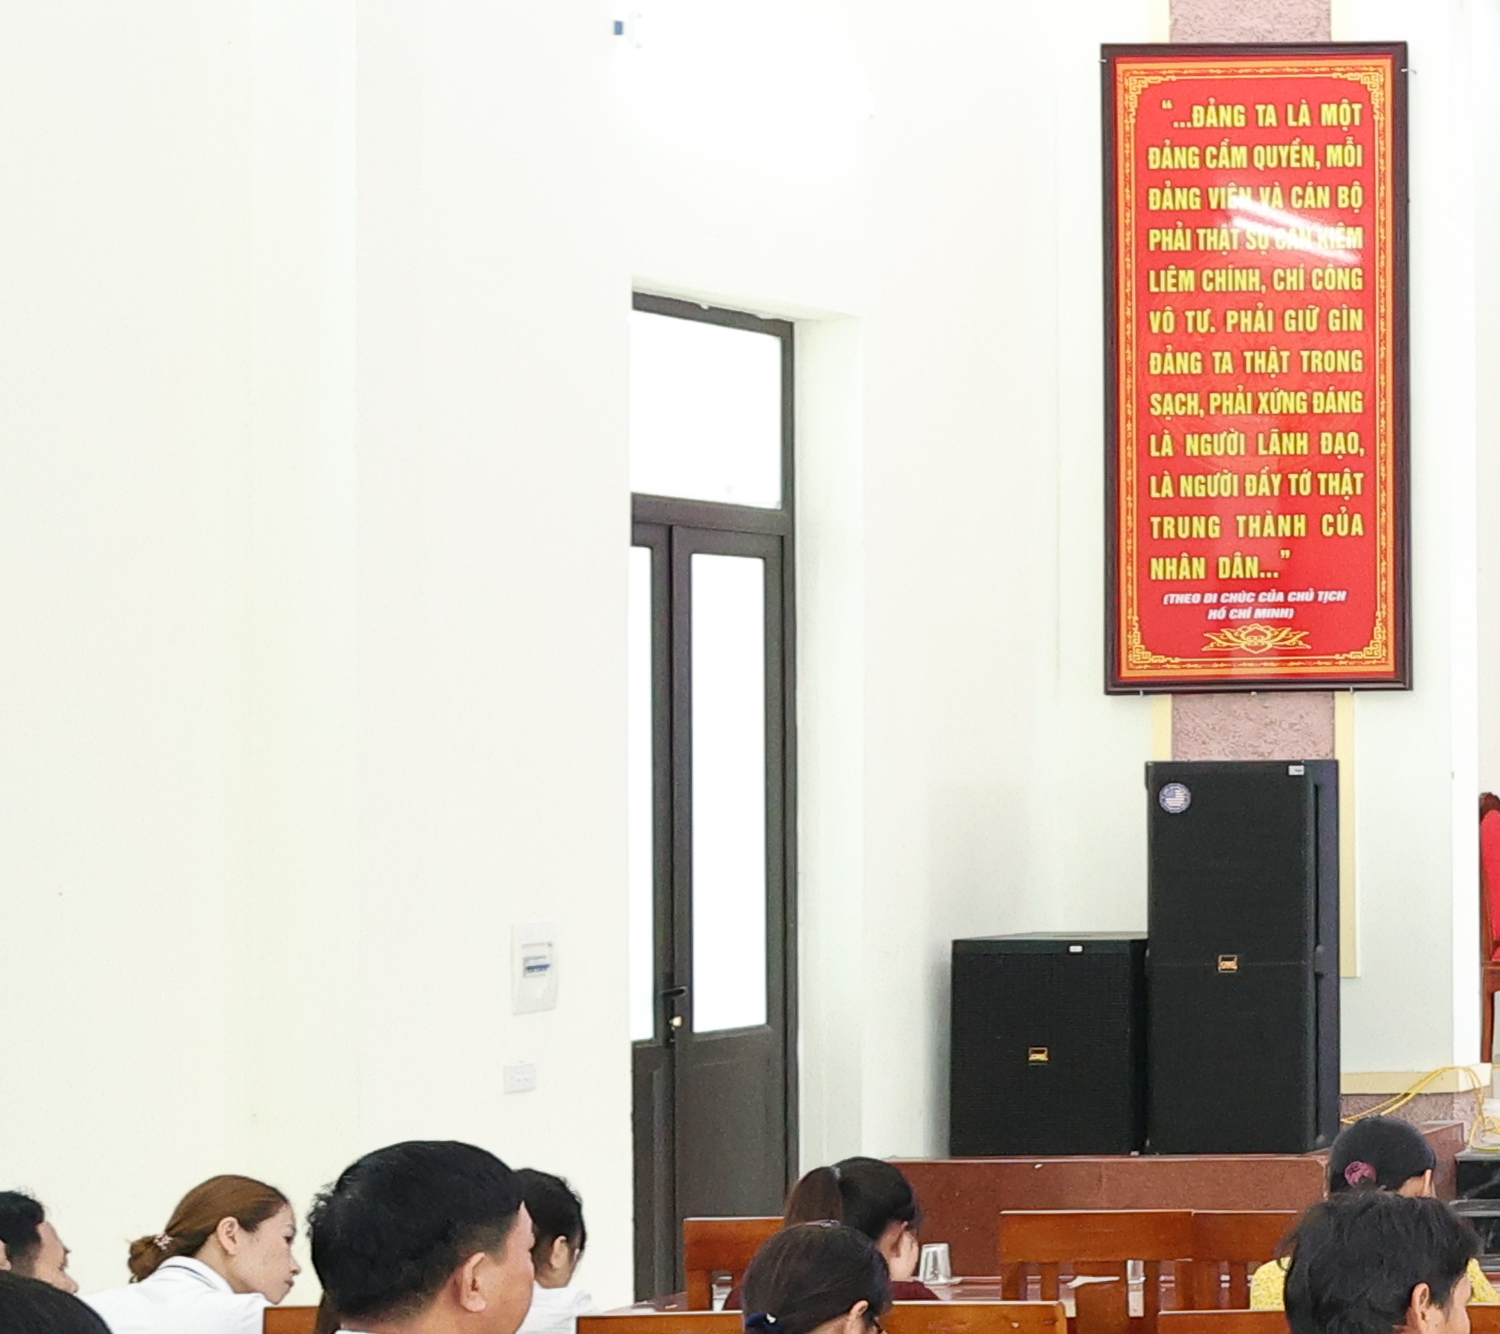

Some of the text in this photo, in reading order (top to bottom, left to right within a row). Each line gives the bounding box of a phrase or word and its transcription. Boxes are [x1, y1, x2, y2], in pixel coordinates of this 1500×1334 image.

[1255, 104, 1278, 127] TA
[1287, 99, 1311, 127] LÀ
[1321, 98, 1363, 131] MỘT
[1148, 139, 1200, 170] ĐẢNG
[1326, 136, 1363, 168] MỖI
[1149, 263, 1363, 294] LIÊM CHÍNH, CHÍ CÔNG
[1149, 306, 1175, 334] VÔ
[1226, 302, 1274, 333] PHẢI
[1284, 305, 1320, 332] GIỮ
[1328, 304, 1363, 332] GÌN
[1149, 344, 1363, 378] ĐẢNG TA THẬT TRONG
[1150, 427, 1365, 459] LÀ NGƯỜI LÃNH ĐẠO,
[1150, 506, 1364, 539] TRUNG THÀNH CỦA
[1150, 552, 1205, 580] NHÂN
